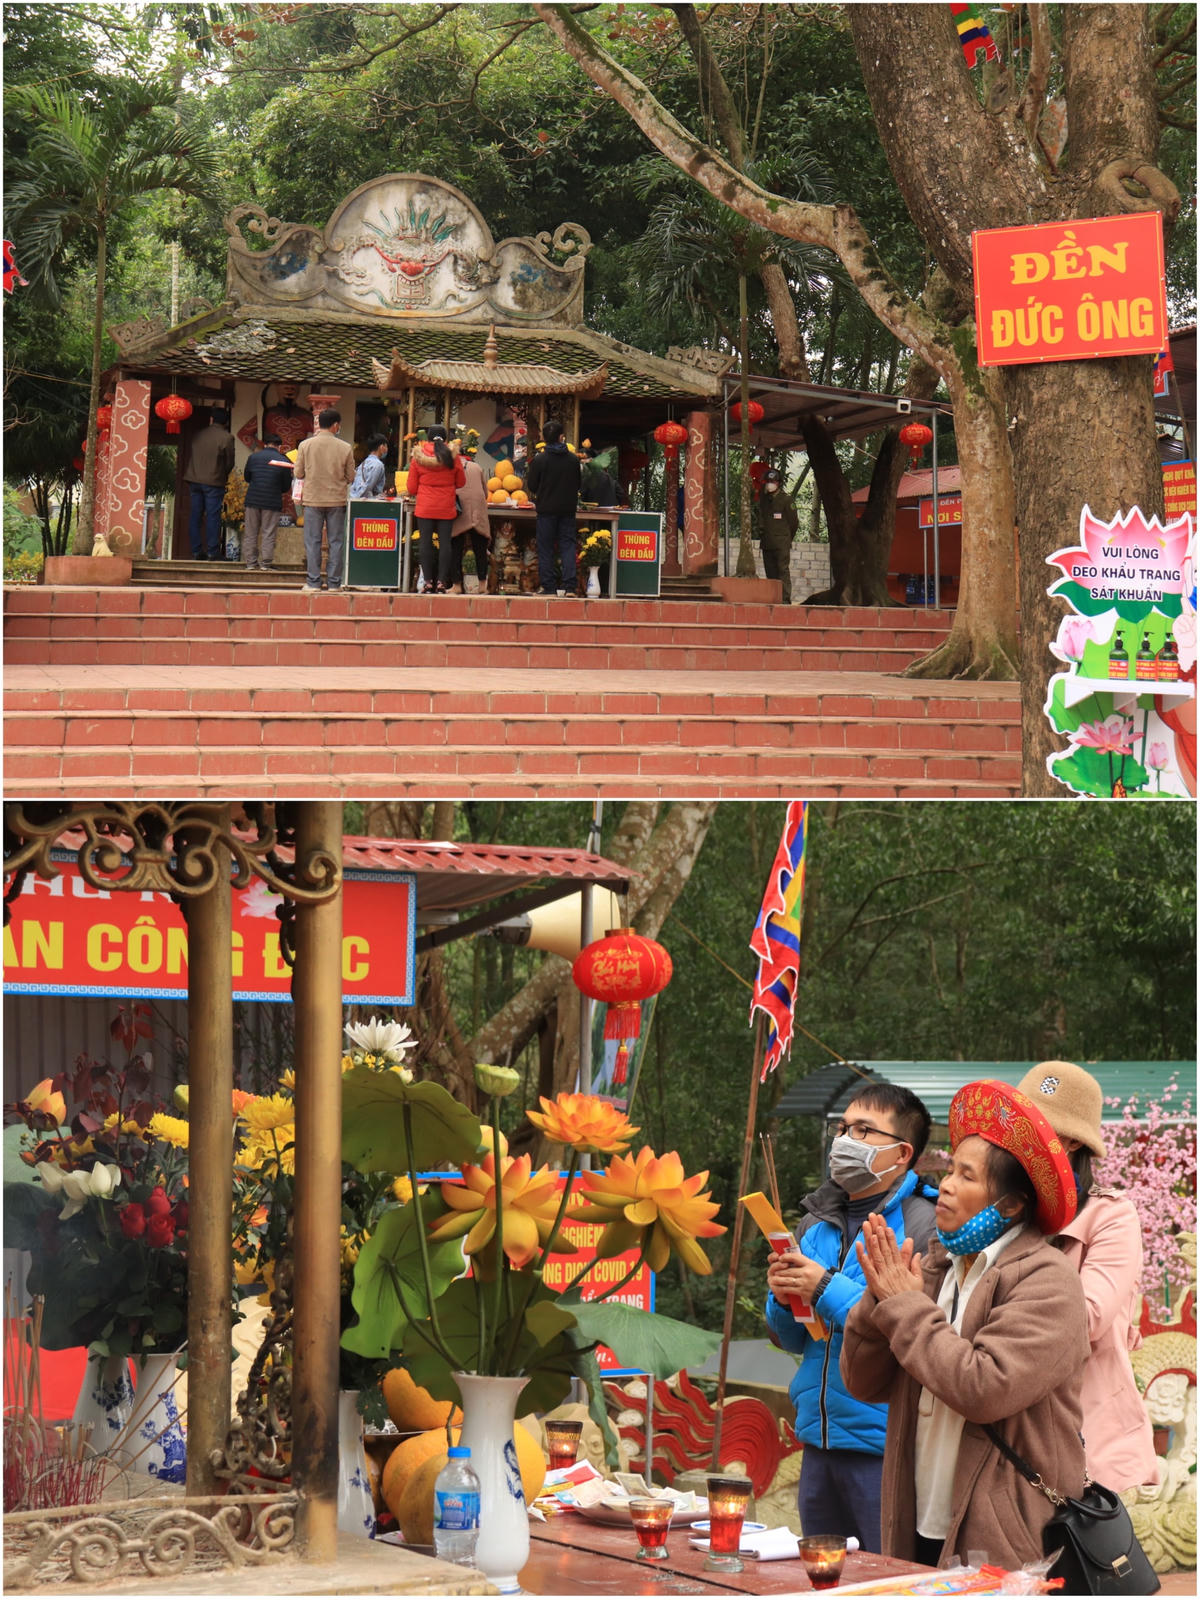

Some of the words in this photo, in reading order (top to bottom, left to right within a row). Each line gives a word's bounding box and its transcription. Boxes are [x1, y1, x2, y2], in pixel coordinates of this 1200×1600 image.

[1010, 230, 1129, 285] ĐỀN
[991, 295, 1064, 348] ĐỨC
[1077, 292, 1154, 342] ÔNG
[1102, 547, 1122, 558] VUI
[1126, 545, 1159, 560] LÒNG
[1073, 566, 1098, 577] ĐEO
[1101, 561, 1136, 579] KHẨU
[1139, 568, 1181, 581] TRANG
[1091, 585, 1115, 599] SÁT
[1119, 583, 1162, 601] KHUẨN
[262, 932, 370, 982] ĐC
[594, 1261, 627, 1282] COVID
